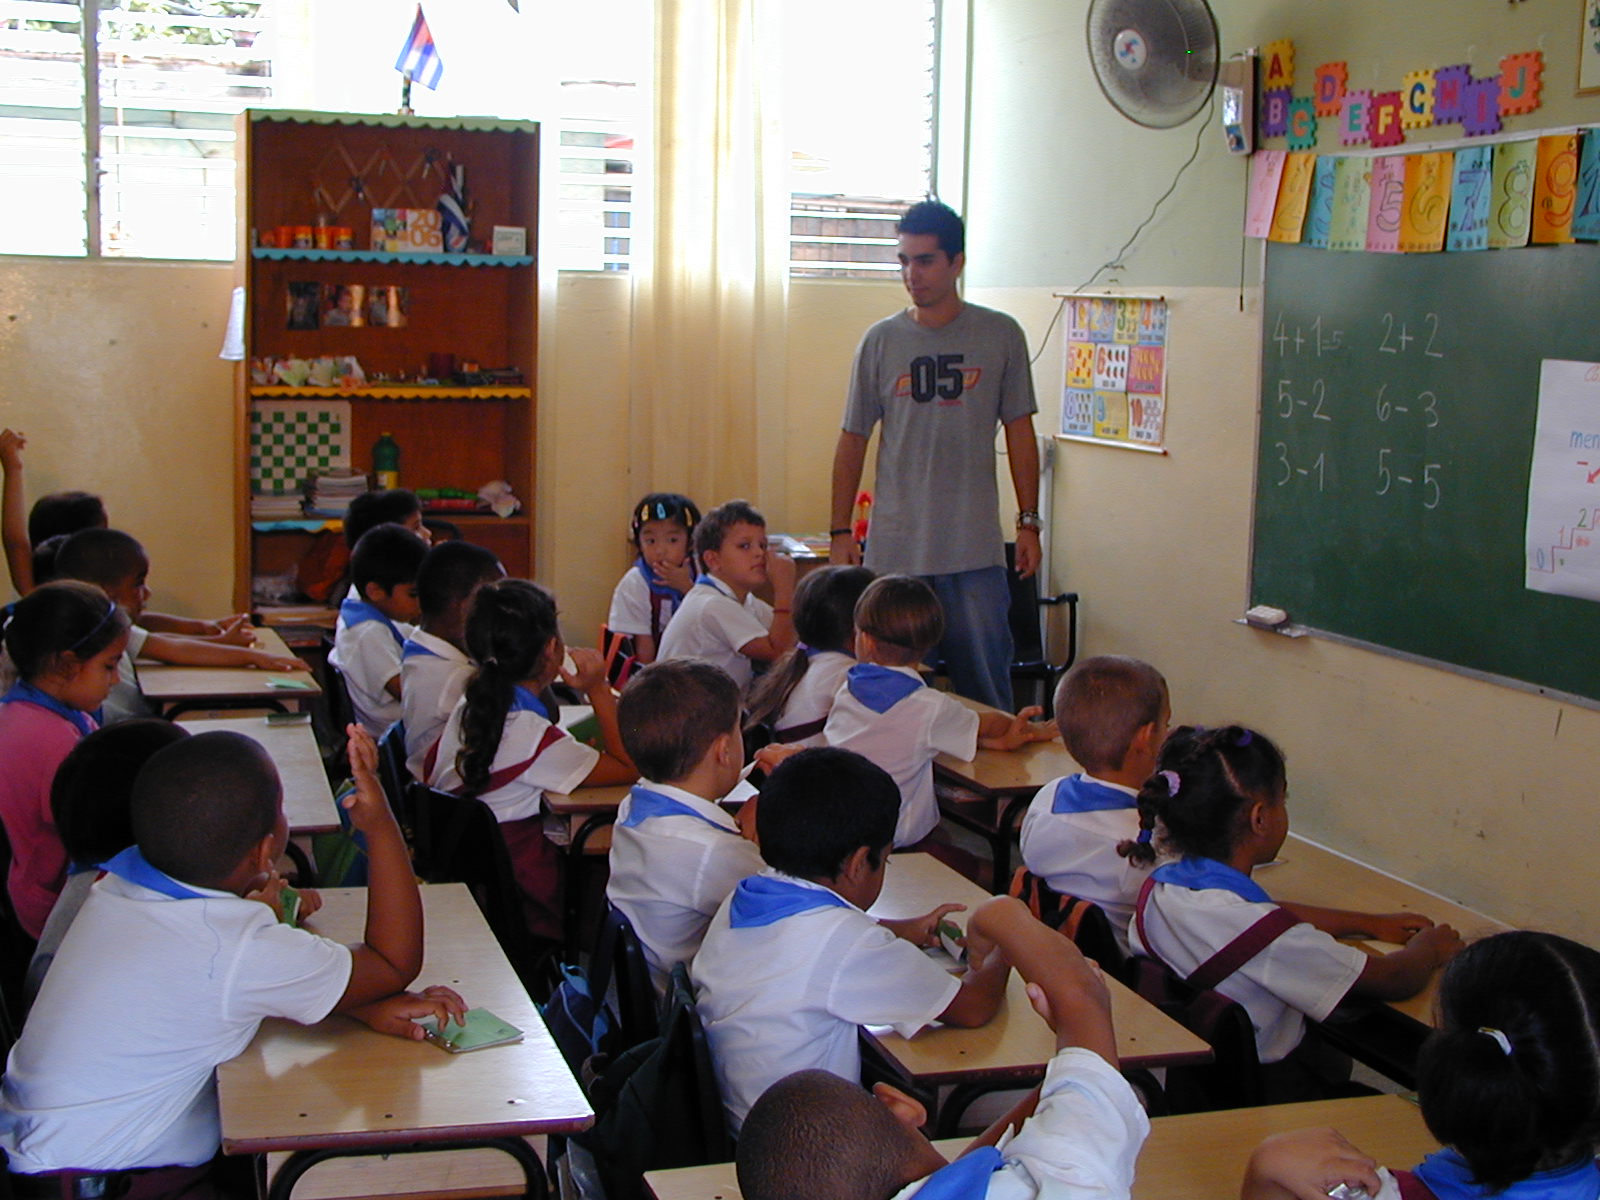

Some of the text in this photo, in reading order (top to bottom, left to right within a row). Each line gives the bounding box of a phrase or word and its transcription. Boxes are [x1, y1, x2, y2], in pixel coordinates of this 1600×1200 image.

[1268, 53, 1284, 79] A
[1321, 75, 1337, 102] D
[1439, 79, 1459, 110] H
[1508, 66, 1526, 99] J
[1269, 97, 1282, 124] B
[1348, 103, 1363, 132] E
[1378, 104, 1395, 135] F
[1476, 91, 1488, 123] I
[1292, 109, 1309, 137] C
[1376, 180, 1404, 232] 5
[1409, 180, 1446, 235] 6
[1459, 169, 1488, 232] 7
[1497, 165, 1530, 240] 8
[1545, 150, 1578, 228] 9
[410, 207, 442, 230] 20
[1117, 299, 1126, 331] 3
[910, 354, 964, 403] 05
[1577, 507, 1588, 528] 2
[1535, 547, 1545, 569] 0
